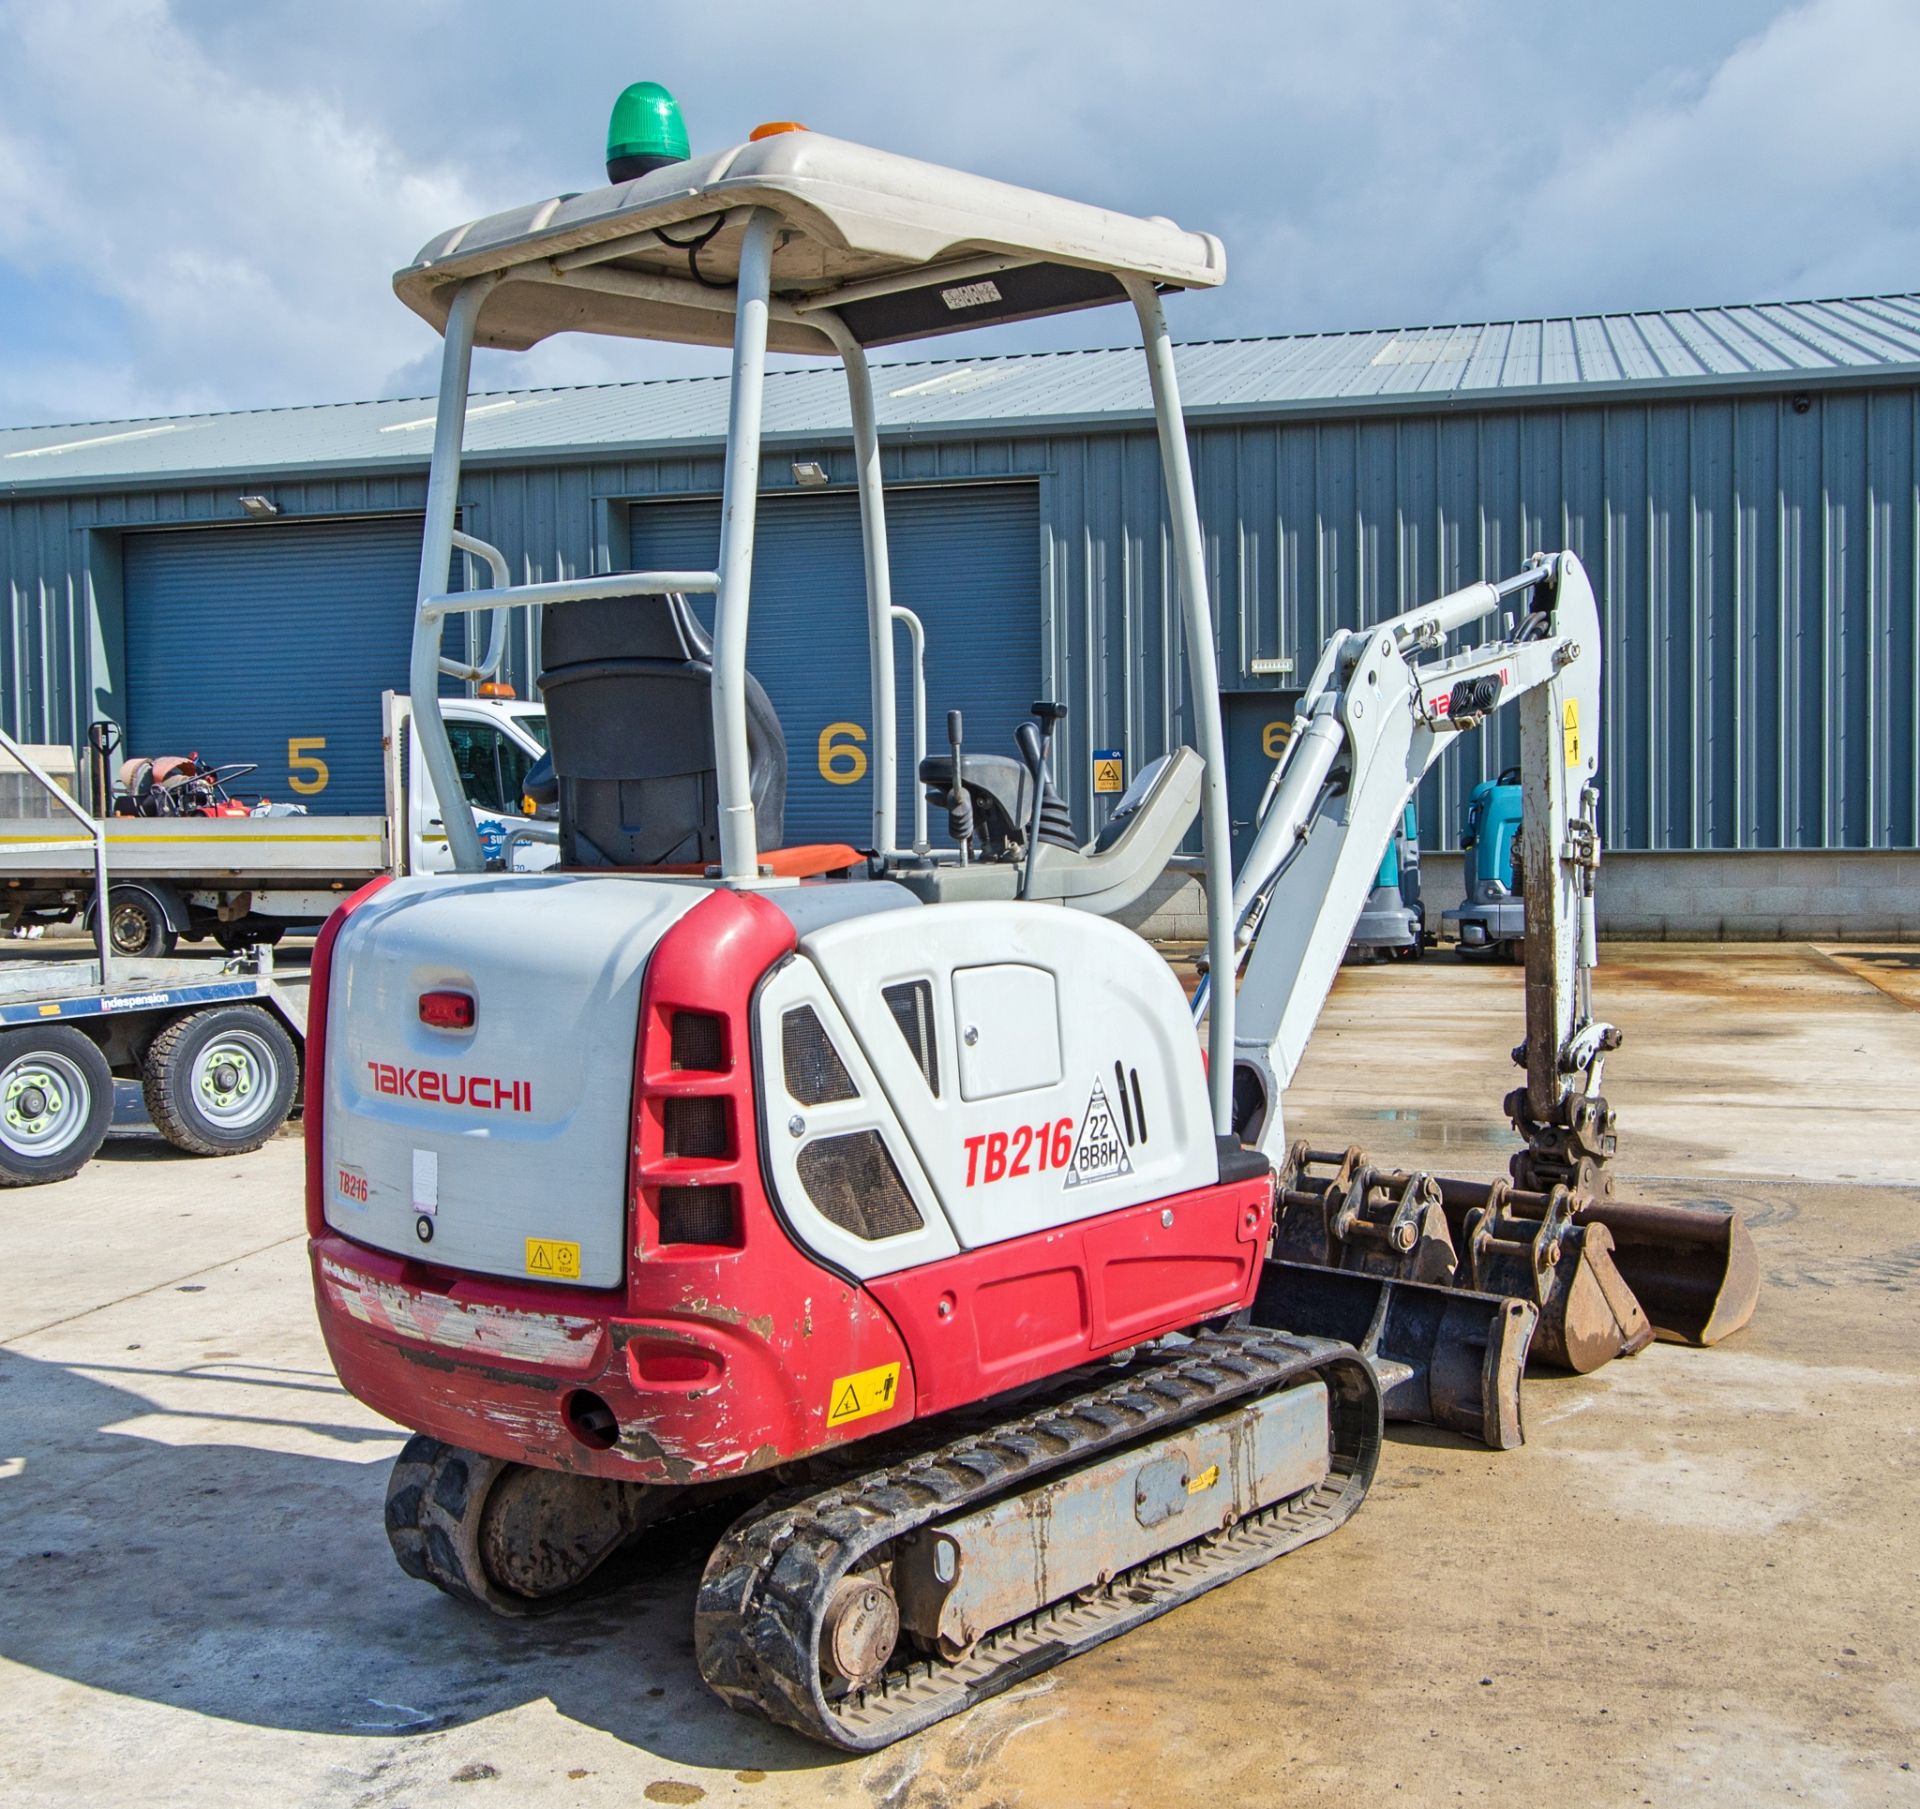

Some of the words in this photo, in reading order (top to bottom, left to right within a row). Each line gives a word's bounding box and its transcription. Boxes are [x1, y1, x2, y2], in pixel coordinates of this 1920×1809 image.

[818, 721, 867, 785] 6
[1263, 721, 1292, 759] 6
[288, 737, 329, 794] 5
[101, 993, 169, 1010] indespension
[1090, 1114, 1109, 1141] 22
[963, 1117, 1074, 1188] TB216
[1080, 1140, 1118, 1172] BB8H
[339, 1170, 368, 1202] TB216
